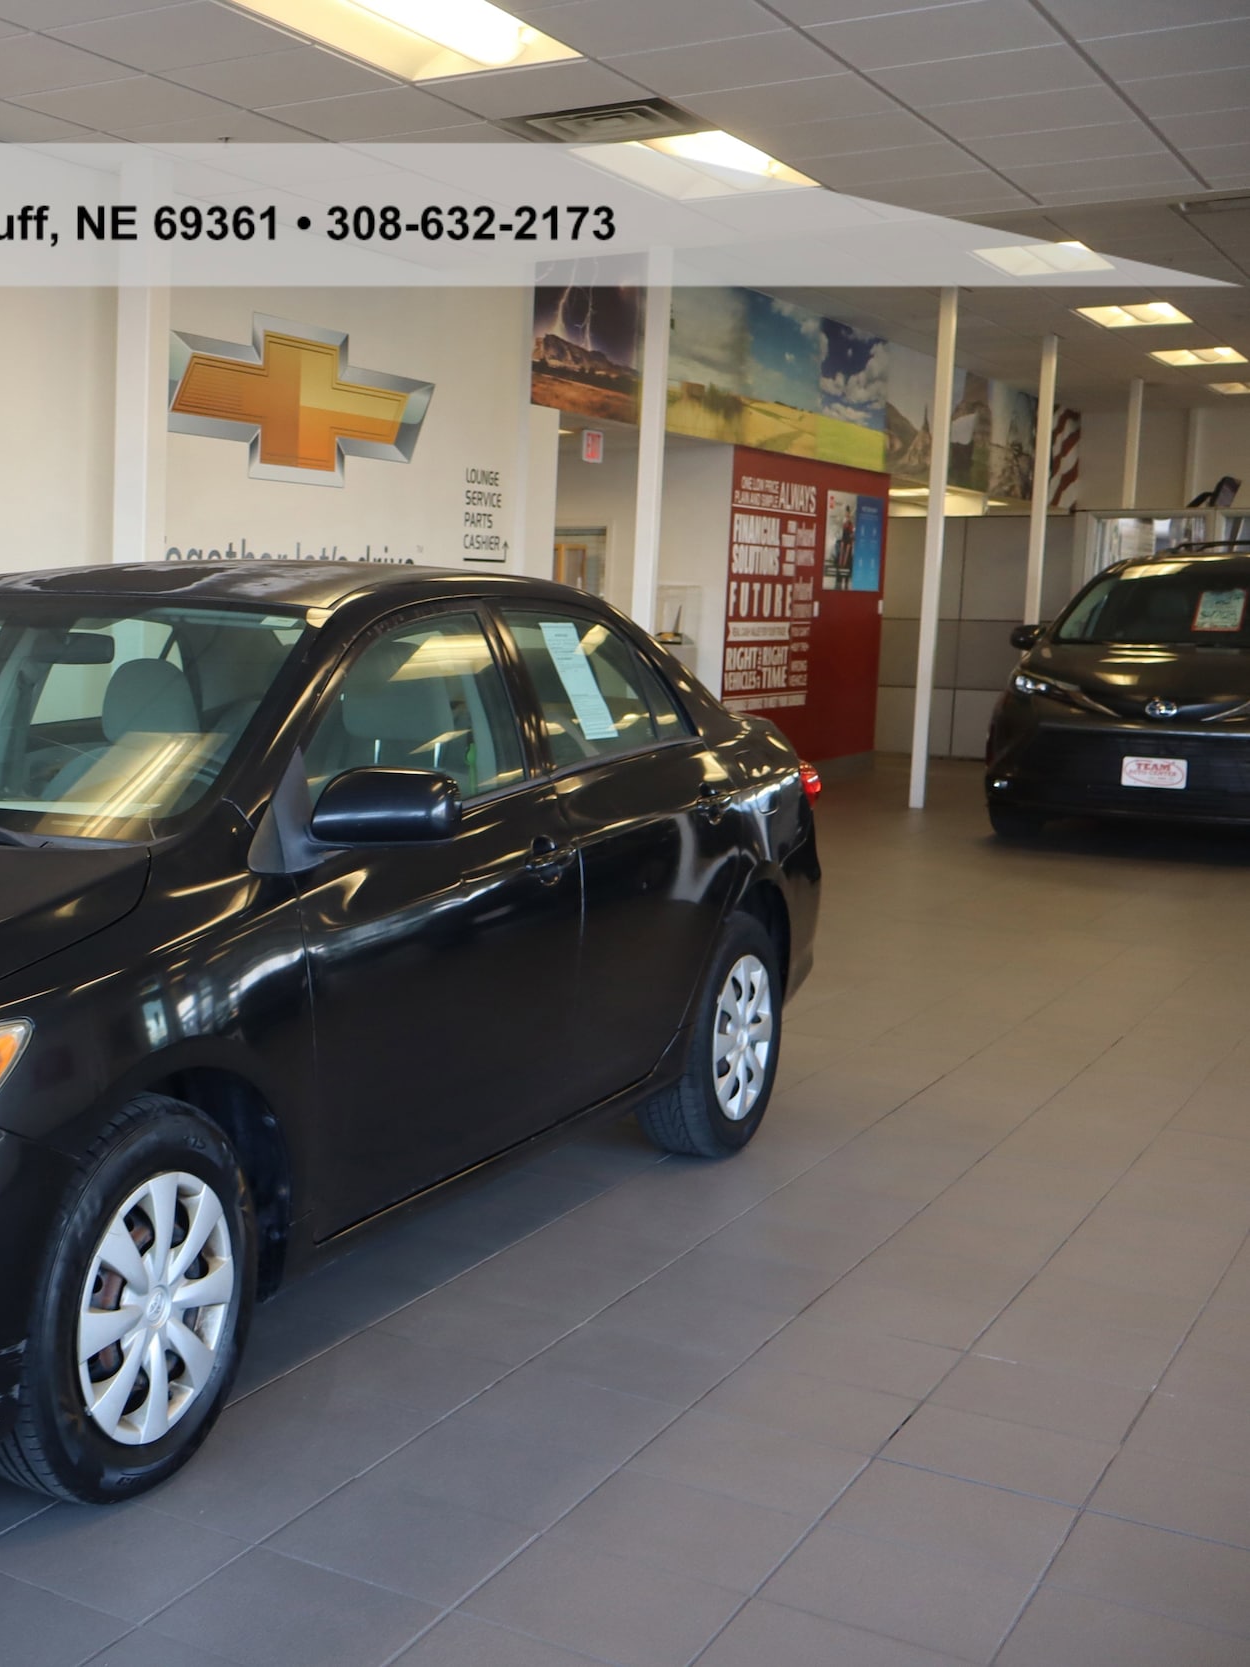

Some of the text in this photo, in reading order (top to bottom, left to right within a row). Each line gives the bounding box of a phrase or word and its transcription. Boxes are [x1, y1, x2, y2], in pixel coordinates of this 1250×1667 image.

[465, 467, 500, 487] LOUNGE
[465, 489, 502, 509] SERVICE
[779, 481, 817, 513] ALWAYS
[464, 511, 493, 529] PARTS
[463, 534, 501, 551] CASHIER
[728, 581, 793, 618] FUTURE
[725, 647, 758, 671] RIGHT
[762, 645, 789, 666] RIGHT
[762, 666, 788, 690] TIME
[1135, 762, 1171, 772] TEAM
